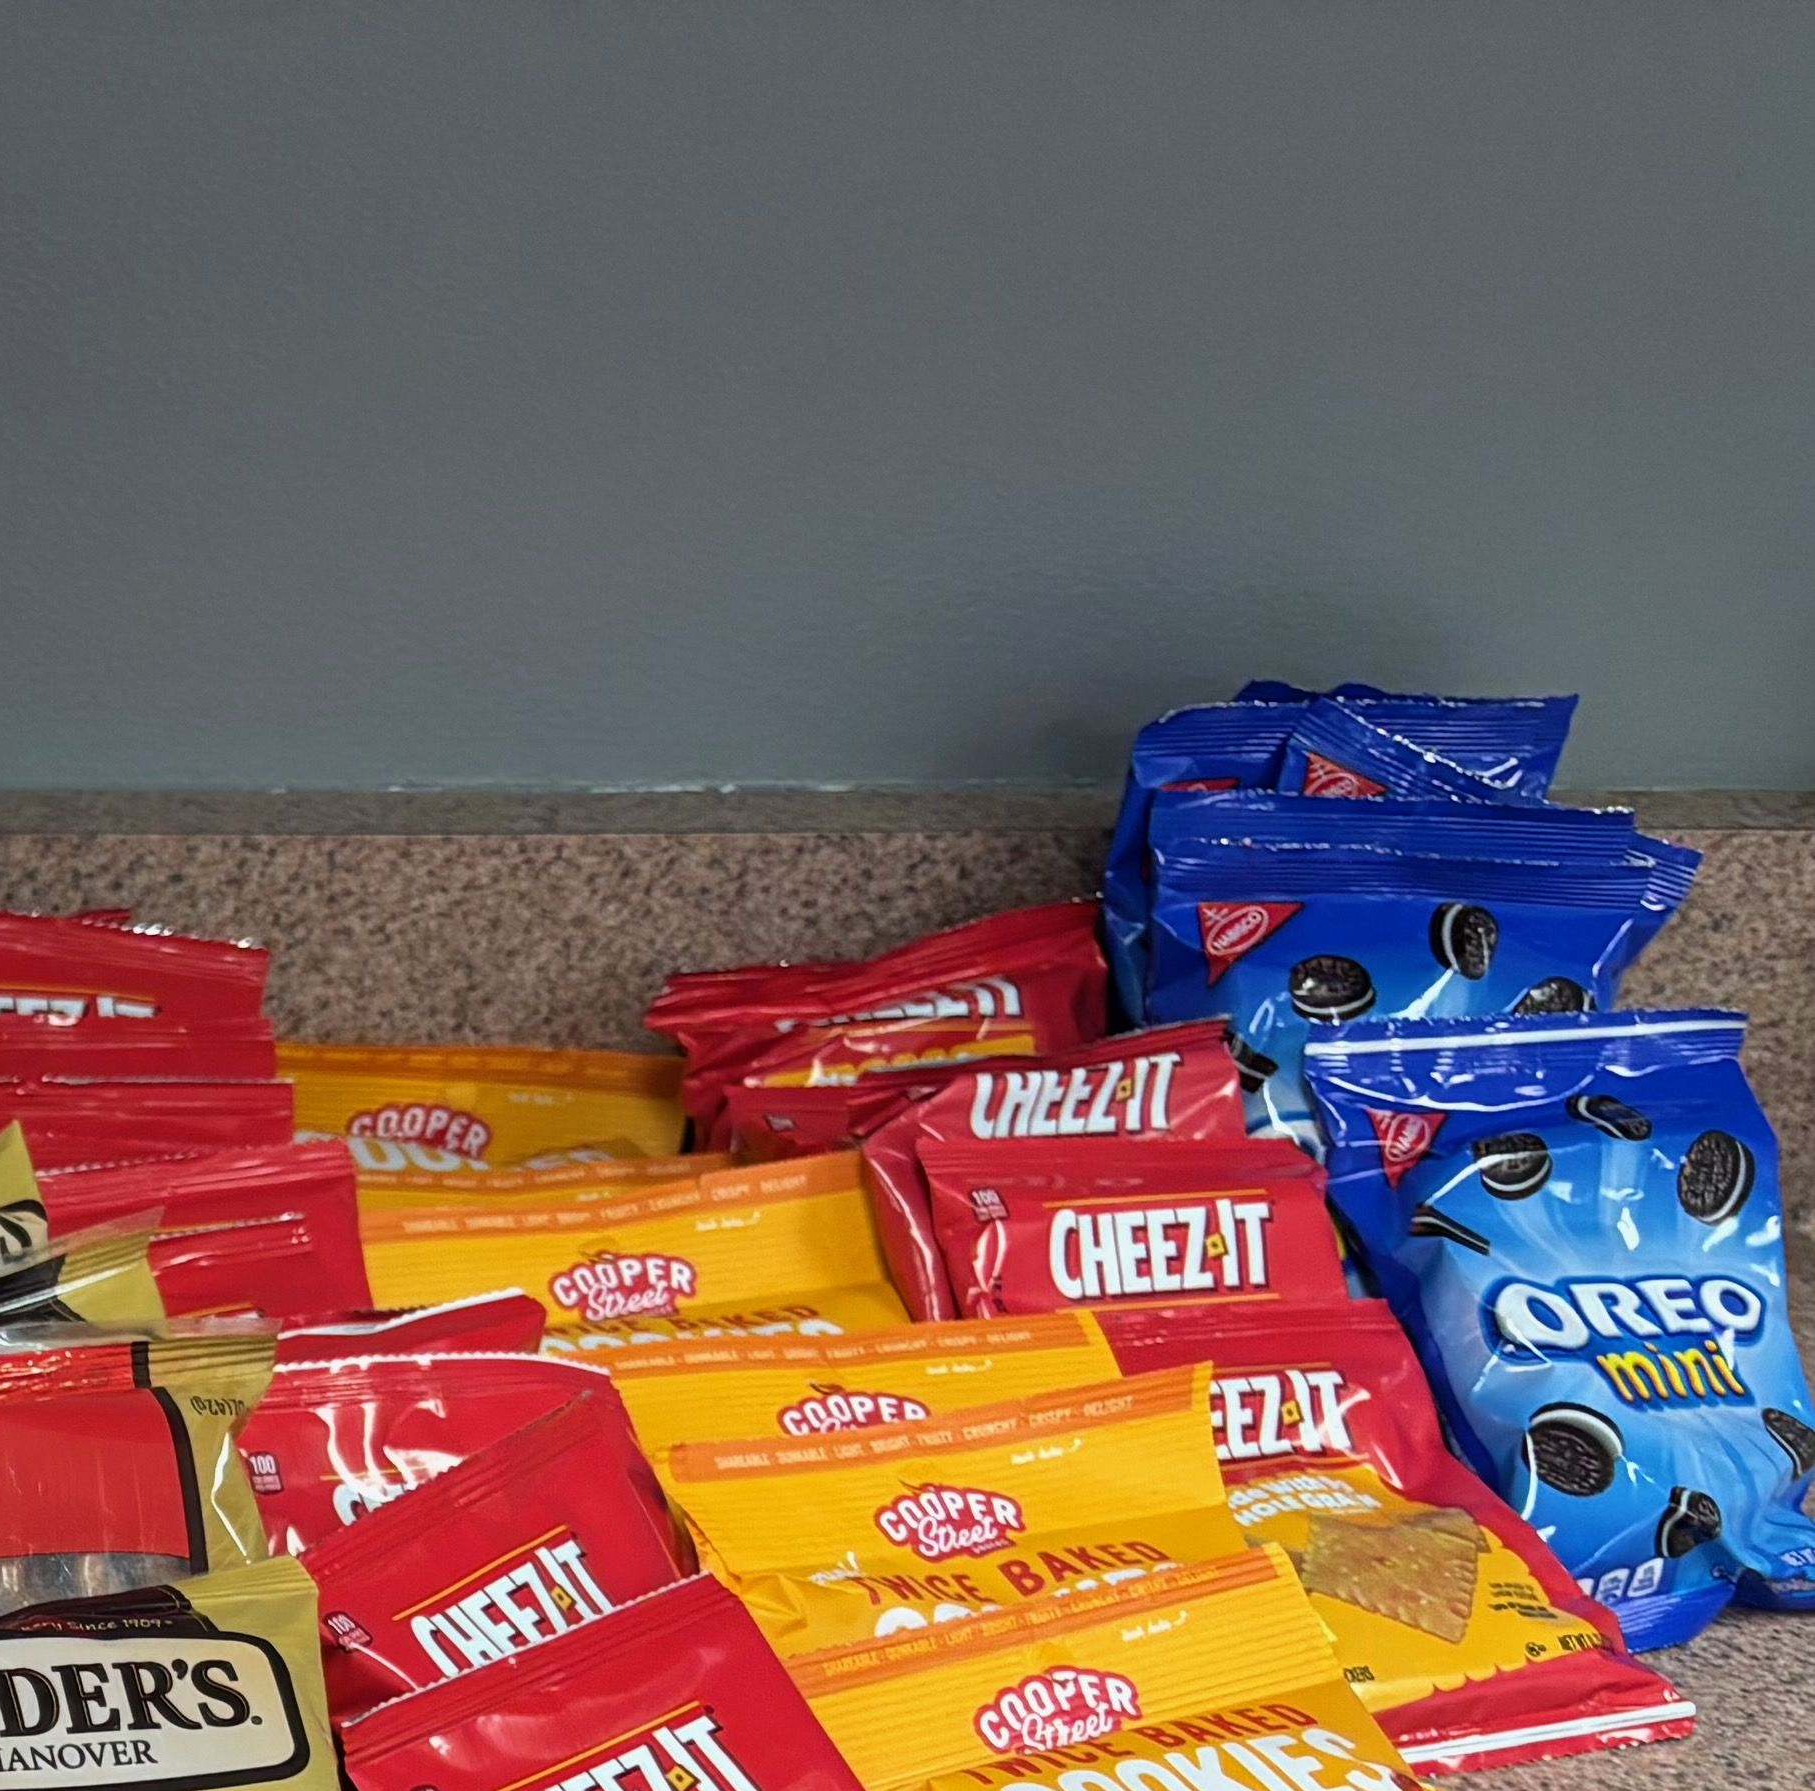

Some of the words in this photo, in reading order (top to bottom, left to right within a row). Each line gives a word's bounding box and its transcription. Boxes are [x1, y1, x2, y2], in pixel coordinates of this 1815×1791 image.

[351, 1104, 492, 1158] COOPER
[585, 1283, 669, 1323] Street
[1495, 1277, 1763, 1350] OREO
[1596, 1341, 1747, 1402] mini
[250, 1454, 276, 1476] 100
[879, 1488, 1022, 1546] COOPER
[918, 1516, 1001, 1558] Street
[979, 1668, 1140, 1747] COOPER
